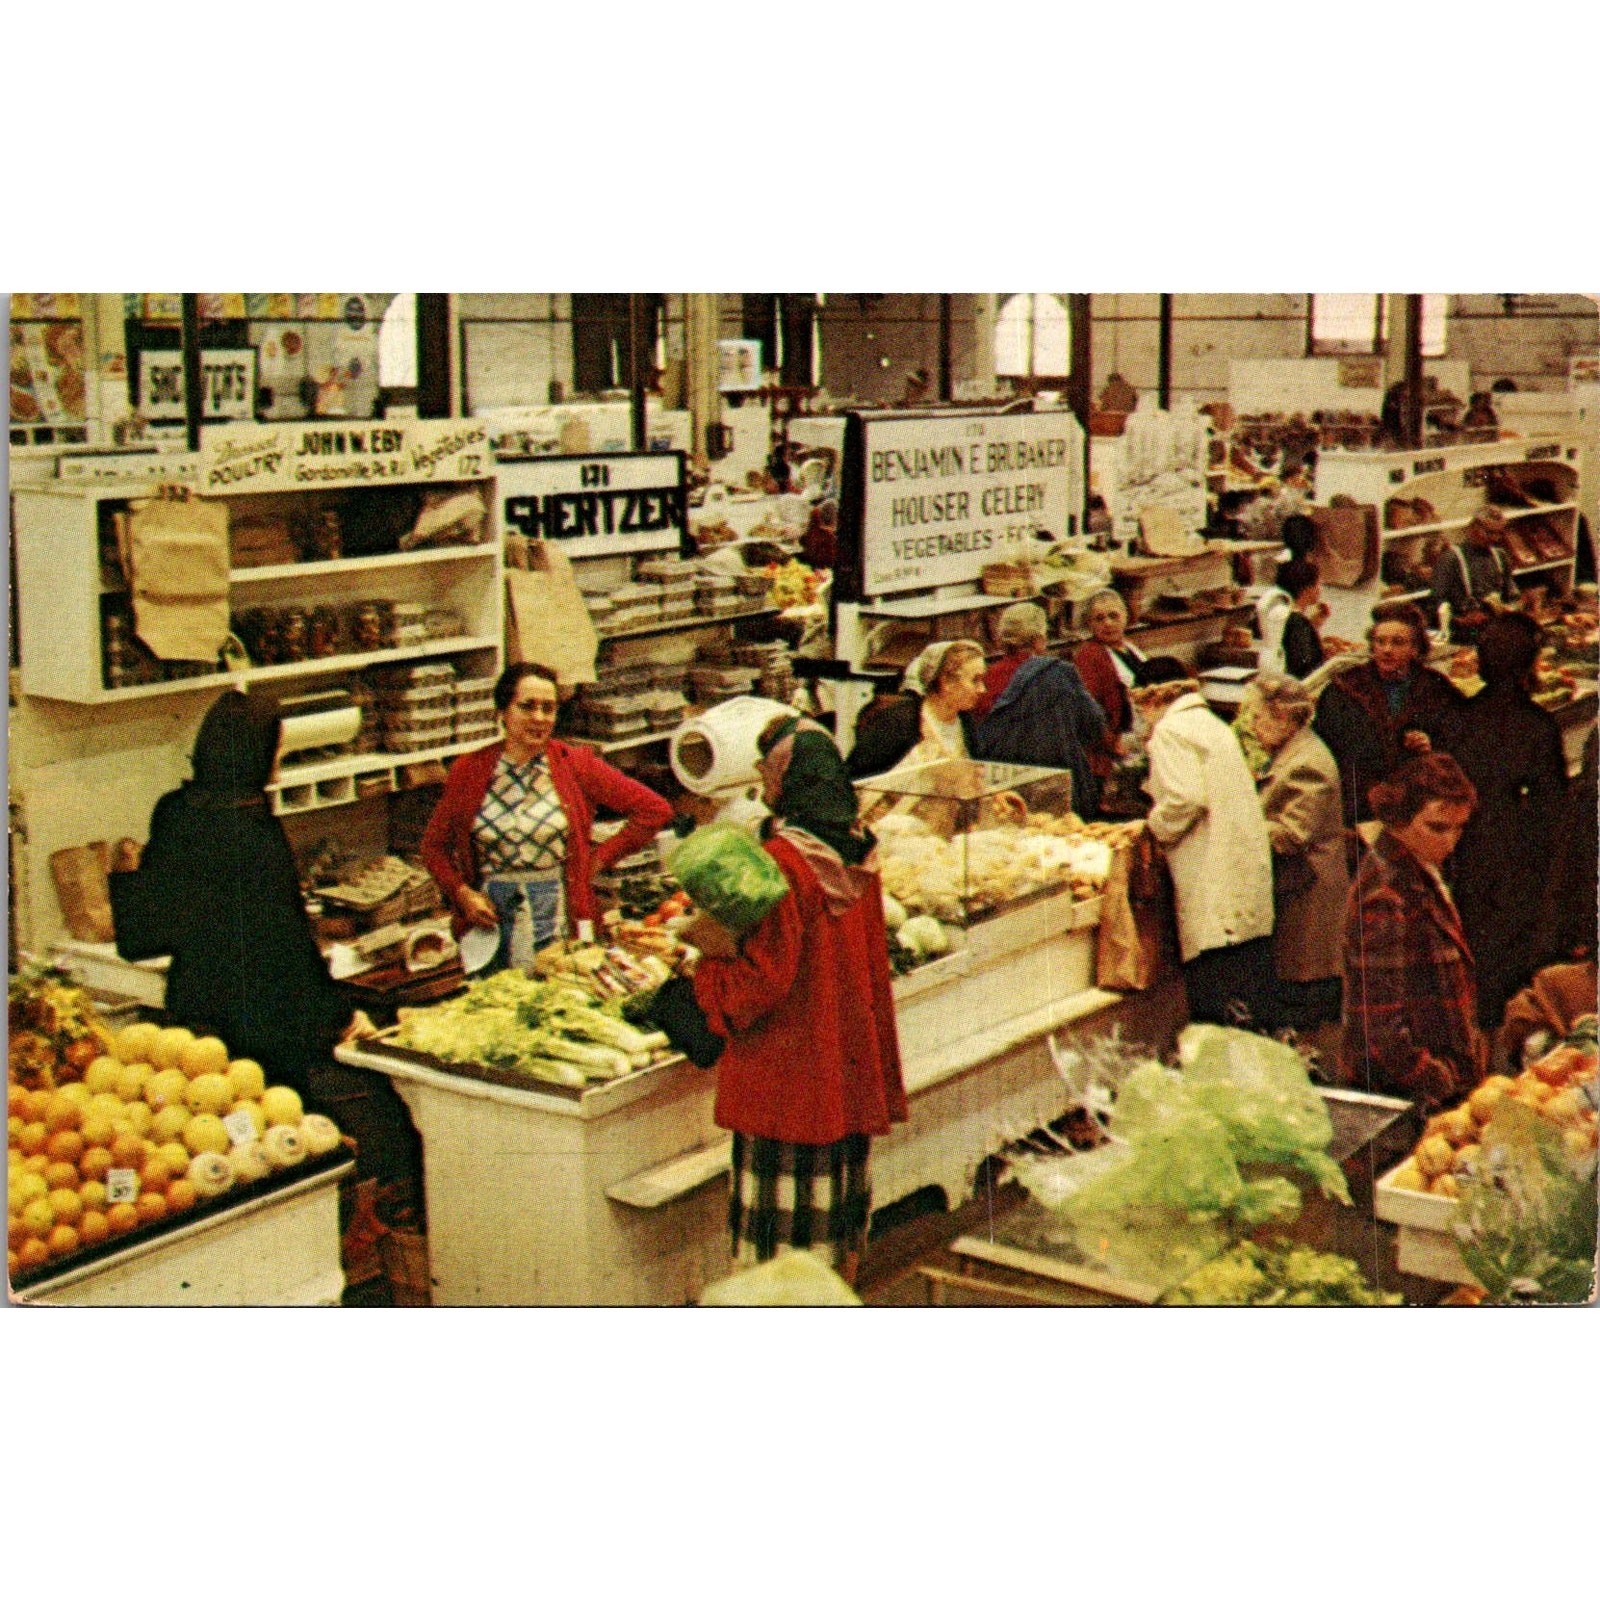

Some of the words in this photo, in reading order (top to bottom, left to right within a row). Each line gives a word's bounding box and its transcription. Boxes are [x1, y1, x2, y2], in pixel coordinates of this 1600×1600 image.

[295, 430, 346, 456] JOHN
[371, 428, 404, 454] EBY
[410, 426, 487, 478] Vegetables
[871, 445, 964, 483] BENJAMIN
[986, 438, 1067, 474] BRUBAKER
[209, 448, 285, 488] POULTRY
[505, 488, 684, 540] SHERTZER
[892, 491, 970, 528] HOUSER
[981, 483, 1047, 517] CELERY
[891, 529, 993, 561] VEGETABLES
